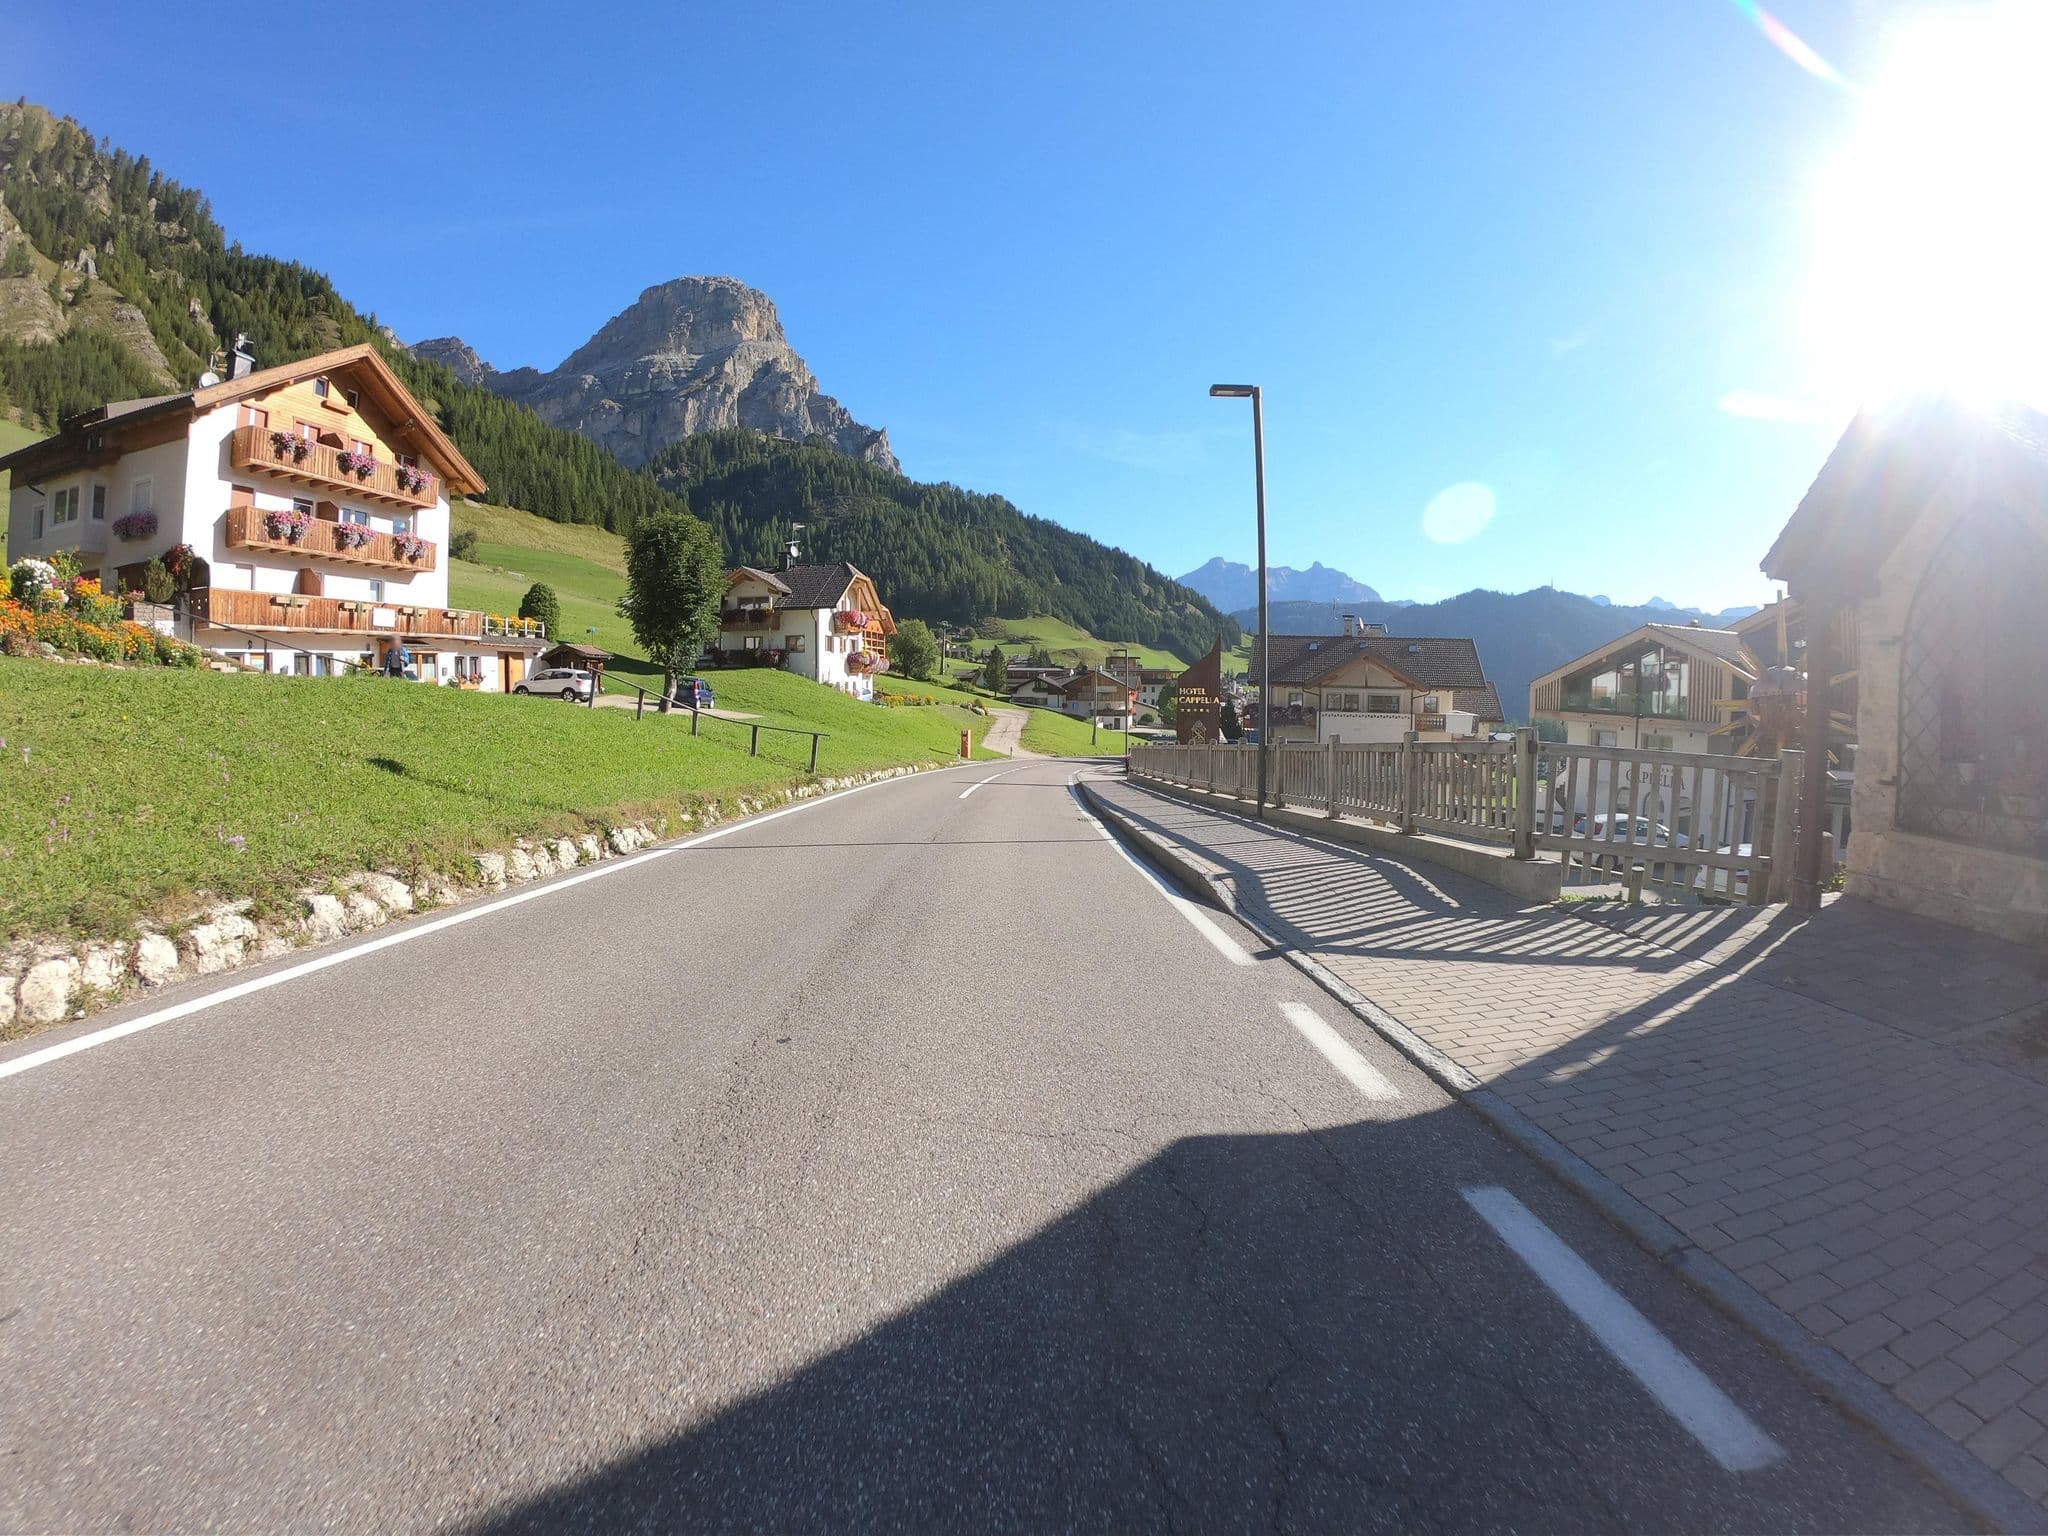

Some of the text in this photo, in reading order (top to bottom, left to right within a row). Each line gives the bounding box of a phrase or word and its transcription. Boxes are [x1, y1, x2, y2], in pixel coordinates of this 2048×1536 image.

[1179, 687, 1206, 695] HOTEL
[1179, 696, 1220, 704] CAPPELLA
[1625, 768, 1686, 791] CPELA
